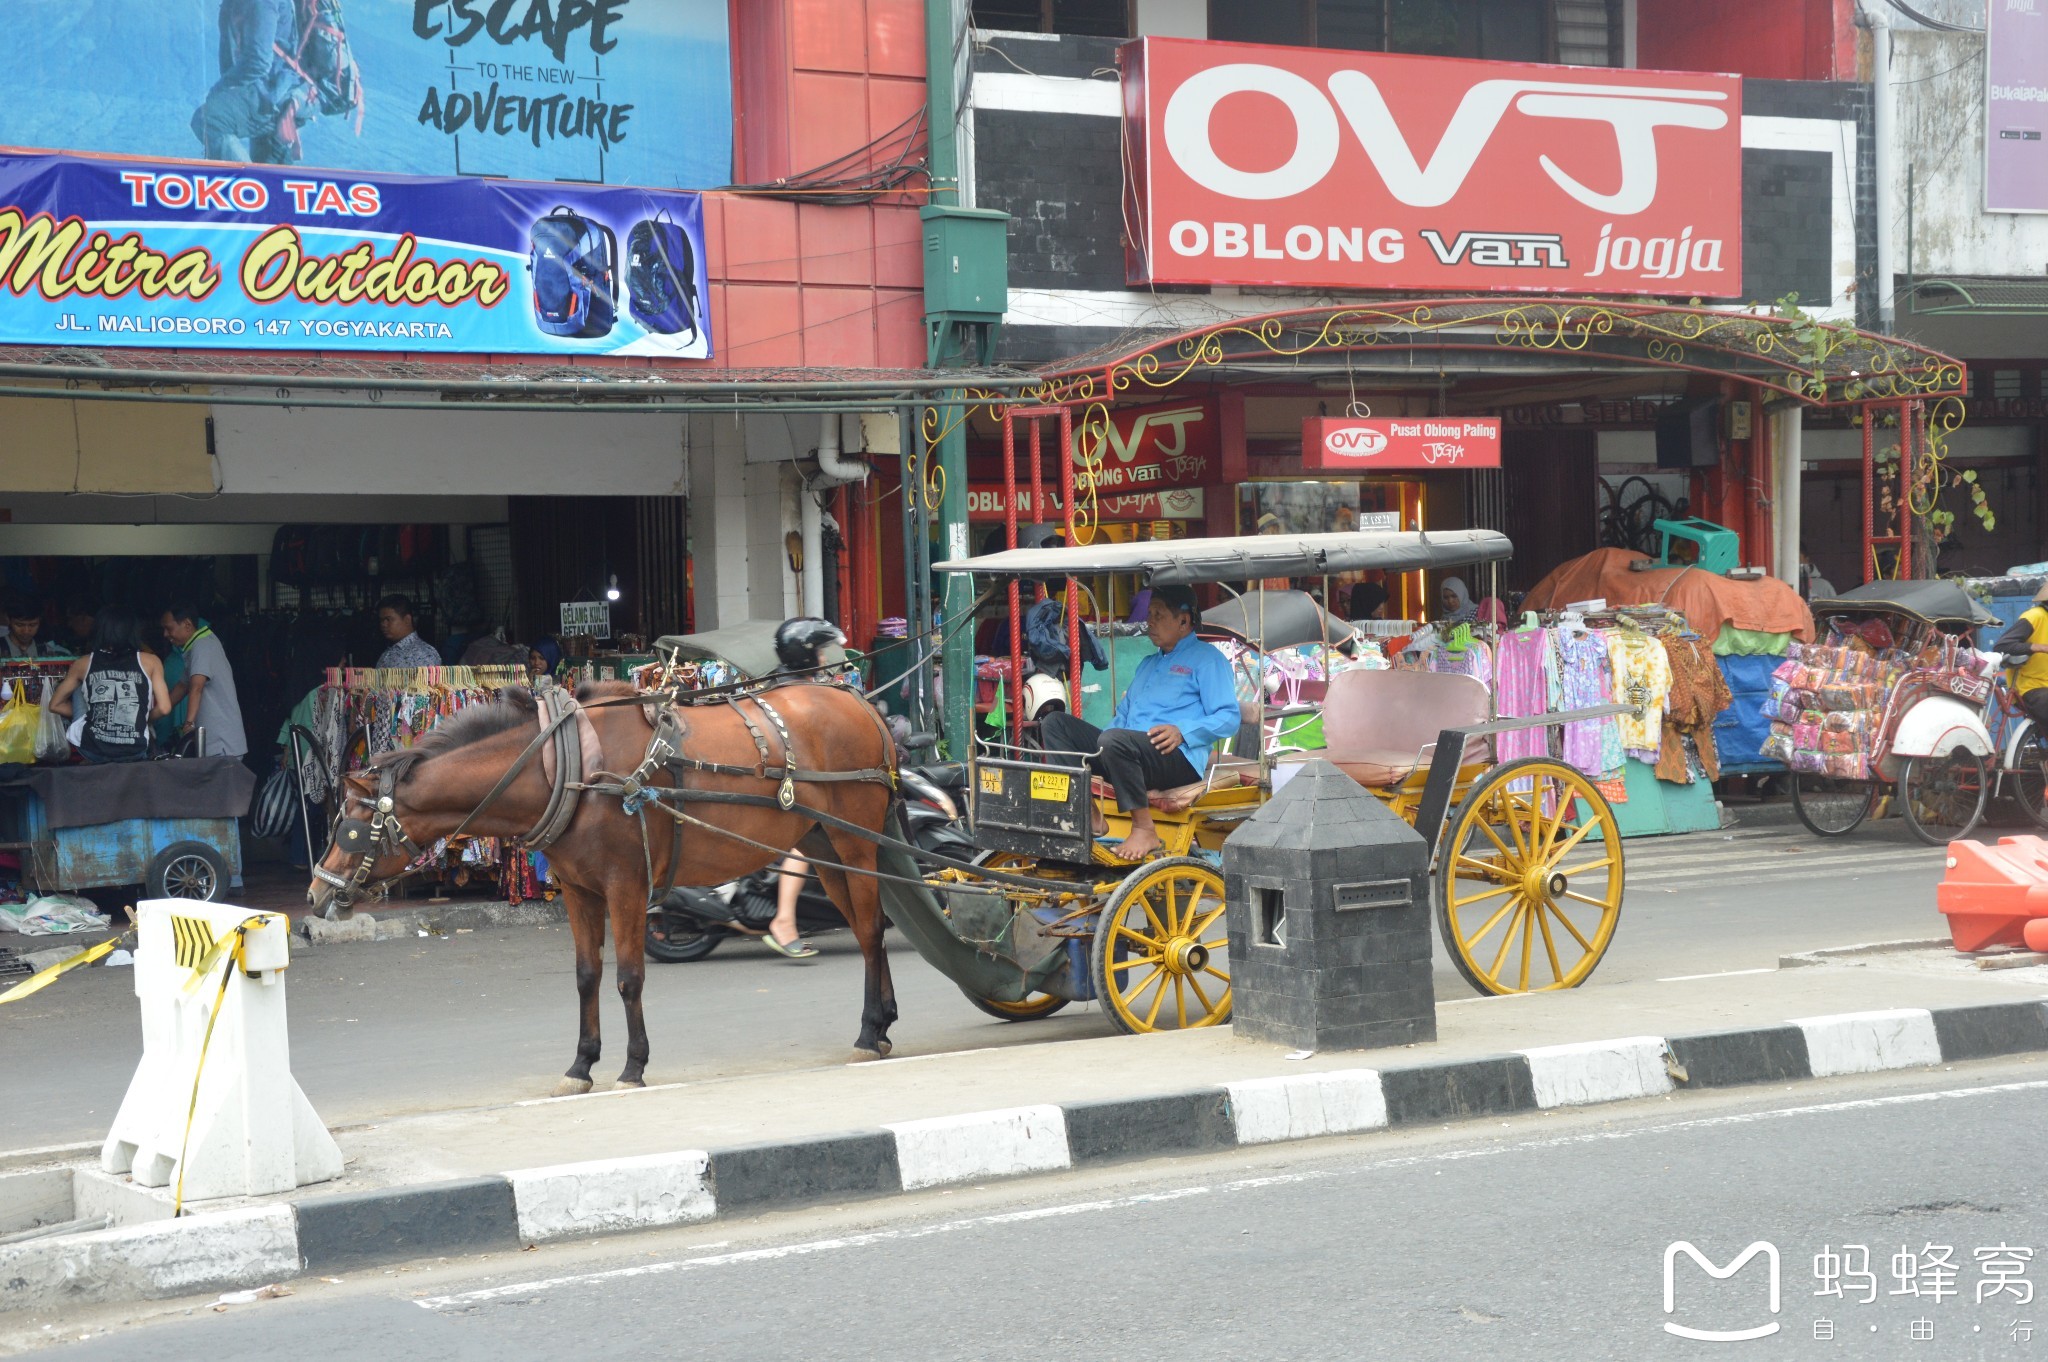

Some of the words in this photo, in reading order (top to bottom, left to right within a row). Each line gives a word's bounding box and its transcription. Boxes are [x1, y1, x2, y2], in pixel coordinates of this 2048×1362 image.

[412, 0, 629, 63] ESCAPE
[476, 62, 498, 79] TO
[502, 64, 533, 82] THE
[537, 67, 575, 85] NEW
[417, 81, 634, 153] ADVENTURE
[122, 172, 268, 210] TOKO
[285, 181, 379, 215] TAS
[0, 207, 221, 302] Mitra
[240, 225, 508, 307] Outdoor
[1169, 220, 1405, 264] OBLONG
[1420, 228, 1570, 268] Van
[1584, 222, 1725, 279] jogja
[55, 313, 91, 332] JL.
[98, 314, 246, 335] MALIOBORO
[253, 318, 290, 335] 147
[300, 320, 453, 339] YOGYAKARTA
[1390, 423, 1421, 437] Pusat
[1424, 423, 1461, 440] Oblong
[1463, 423, 1496, 440] Paling
[967, 491, 1045, 512] OBLN
